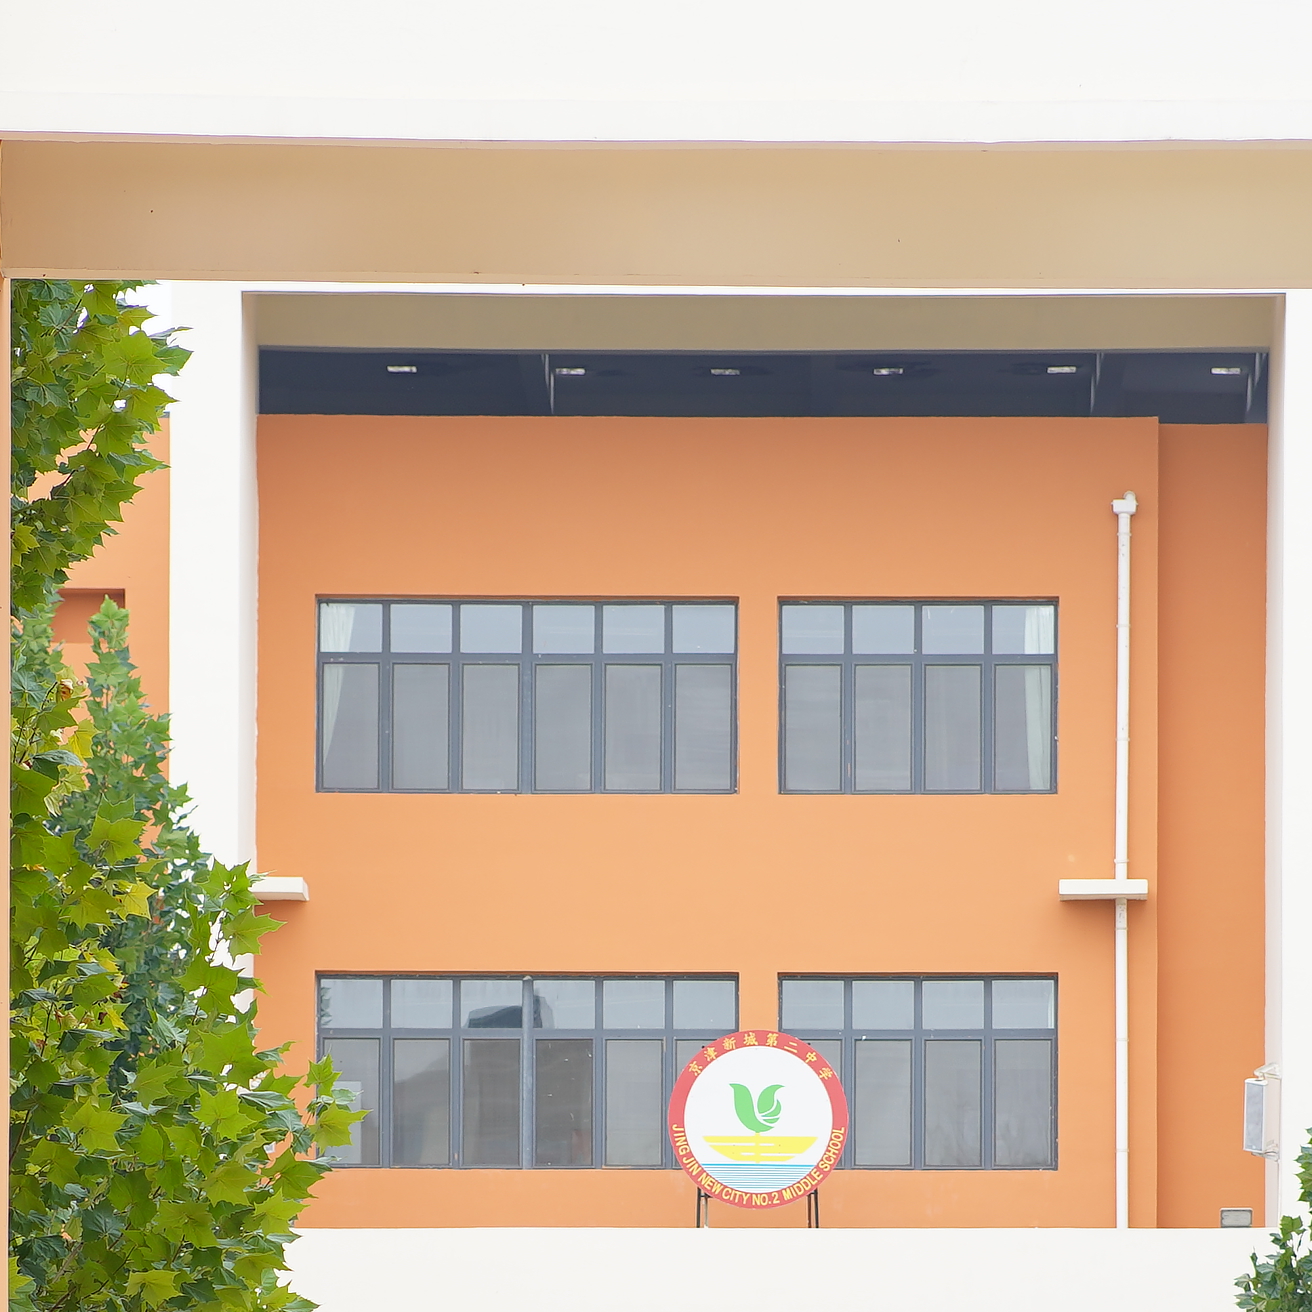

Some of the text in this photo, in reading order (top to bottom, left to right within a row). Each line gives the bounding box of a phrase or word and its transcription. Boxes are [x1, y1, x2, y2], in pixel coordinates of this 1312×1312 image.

[689, 1032, 833, 1081] 京津新城第二中学
[672, 1123, 690, 1155] JING
[682, 1150, 705, 1177] JIN
[698, 1172, 722, 1195] NEW
[722, 1187, 751, 1205] CITY
[782, 1168, 824, 1201] MIDDLE
[818, 1127, 845, 1173] SCHOOL
